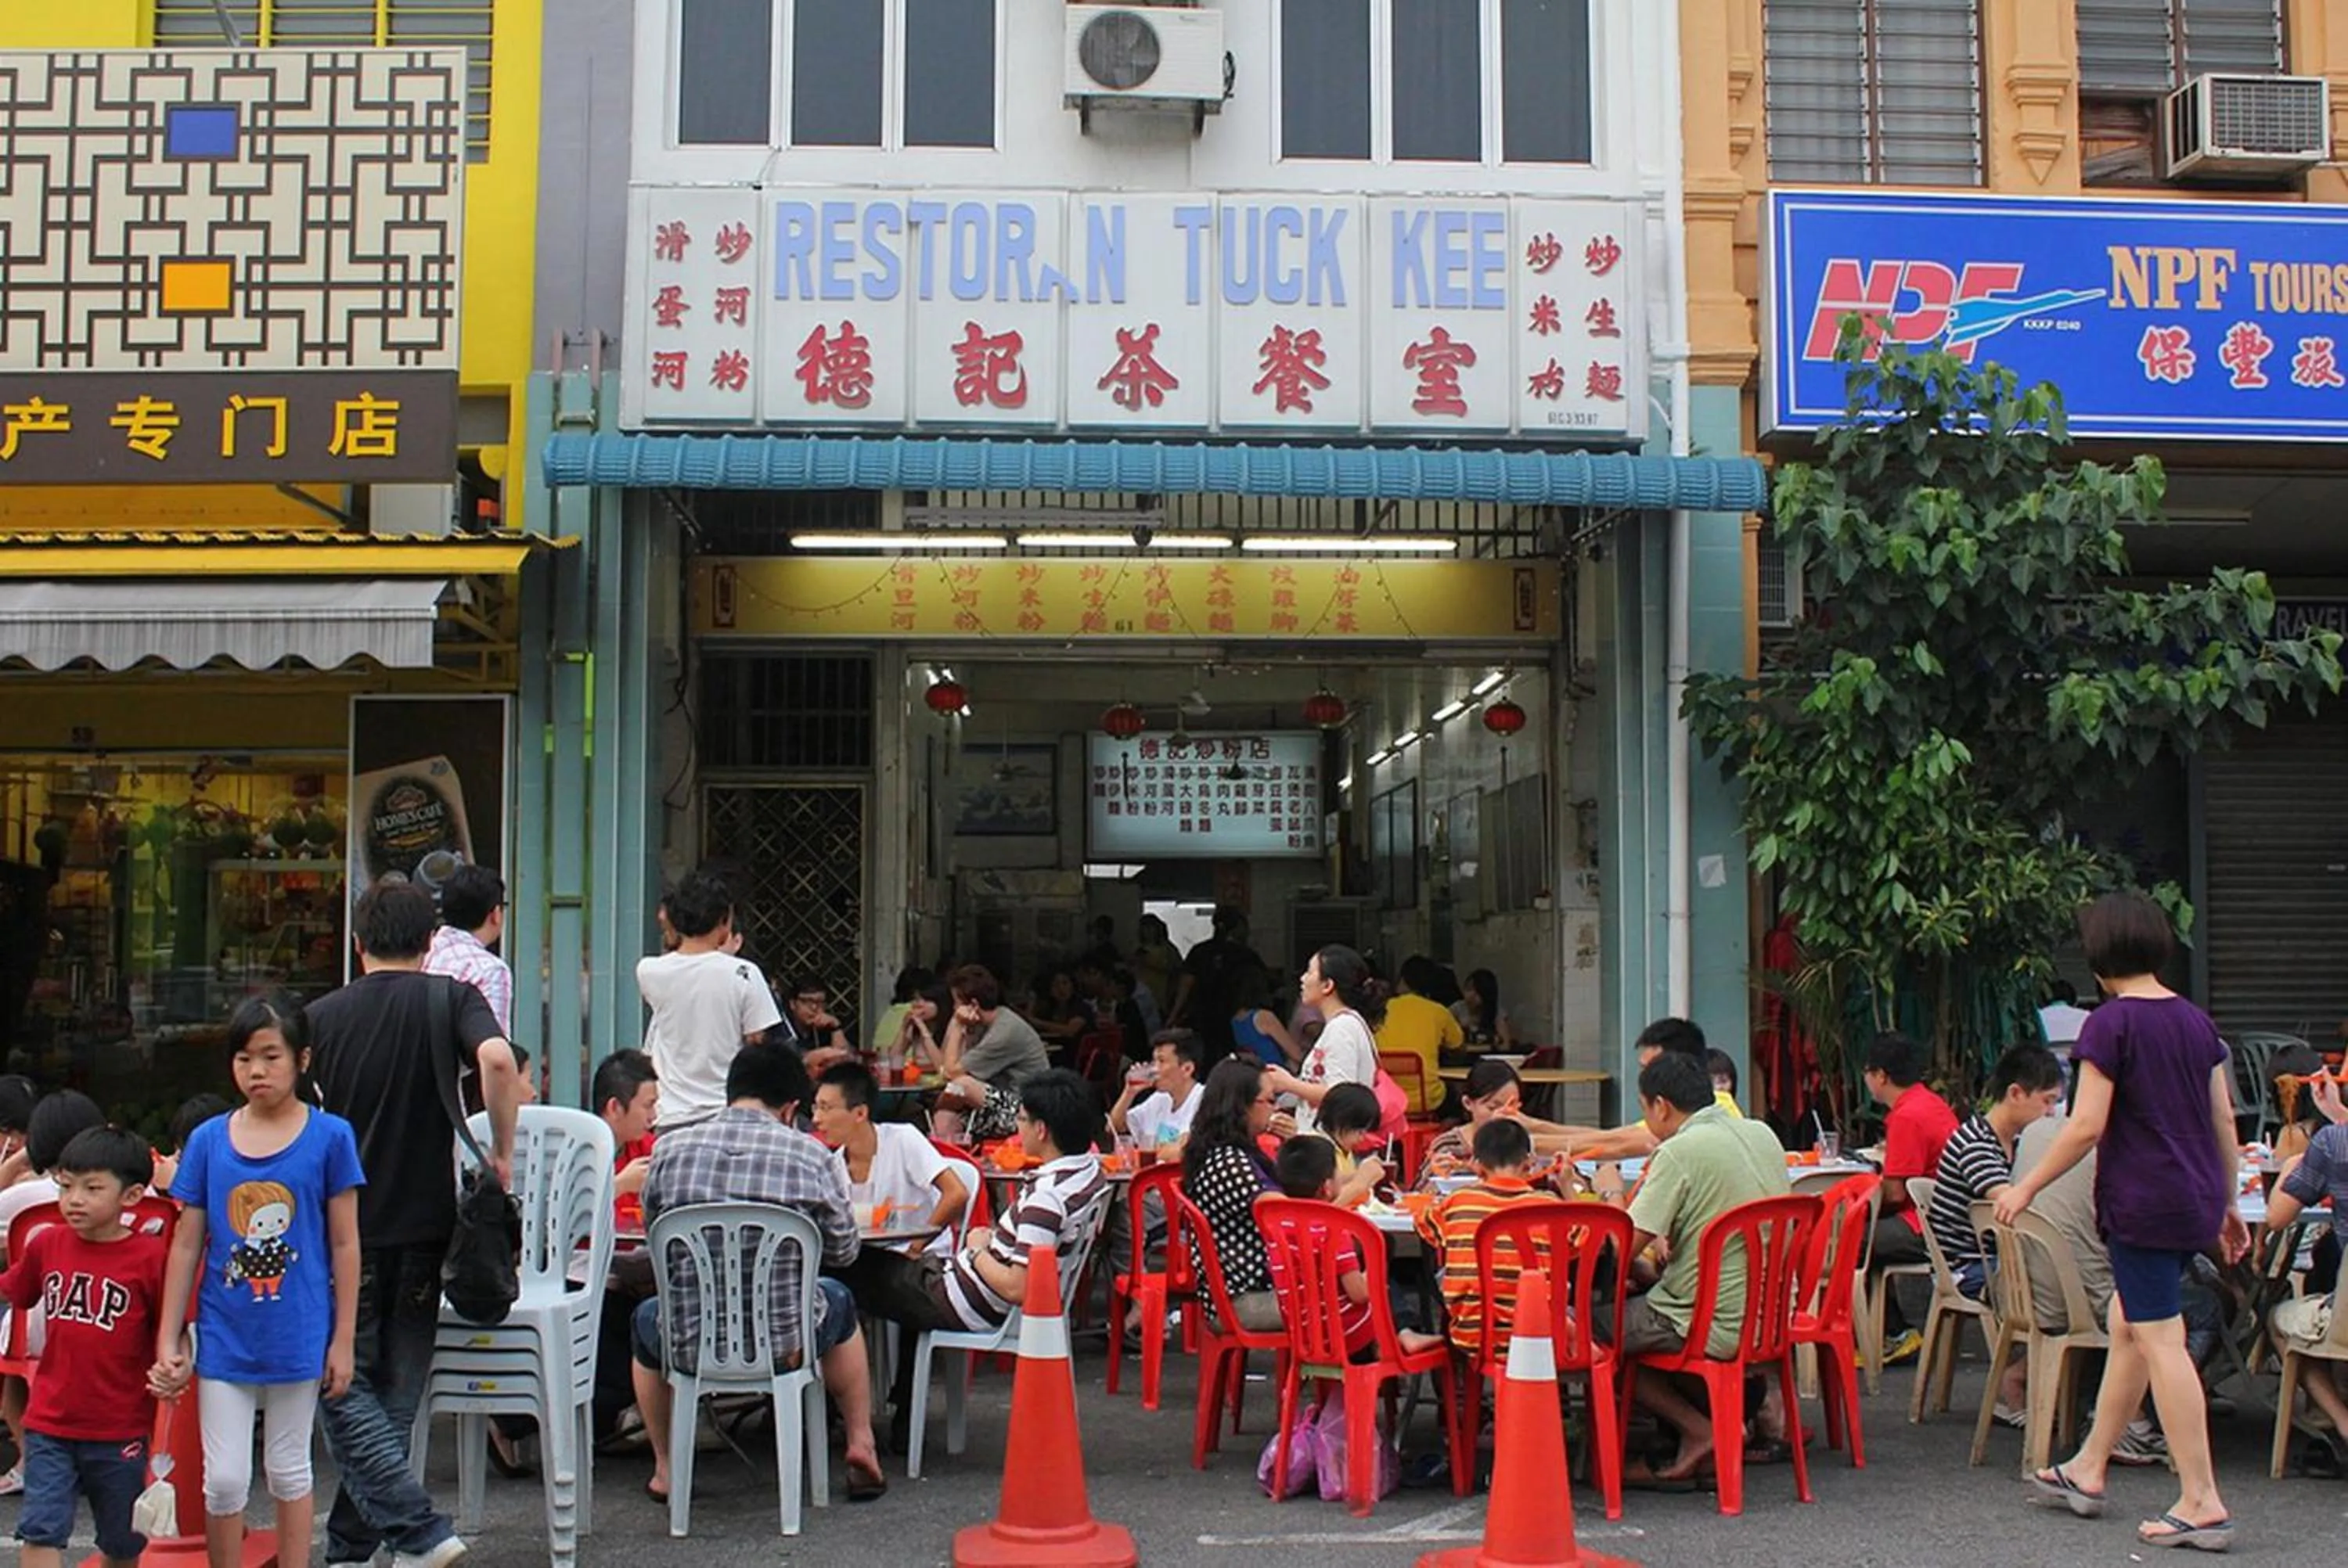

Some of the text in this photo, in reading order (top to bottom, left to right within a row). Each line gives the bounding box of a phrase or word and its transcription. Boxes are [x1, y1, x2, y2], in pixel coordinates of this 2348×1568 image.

[1173, 205, 1348, 307] TUCK
[1391, 210, 1505, 310] KEE
[2108, 246, 2348, 314] NPF TOURS
[651, 220, 691, 391] 滑蛋河
[709, 221, 752, 391] 炒河粉
[794, 319, 1478, 419] 德記茶餐室
[2137, 322, 2346, 389] 保豐旅
[0, 391, 403, 462] 产专门店
[2275, 606, 2348, 641] RAVEL
[45, 1271, 131, 1331] GAP
